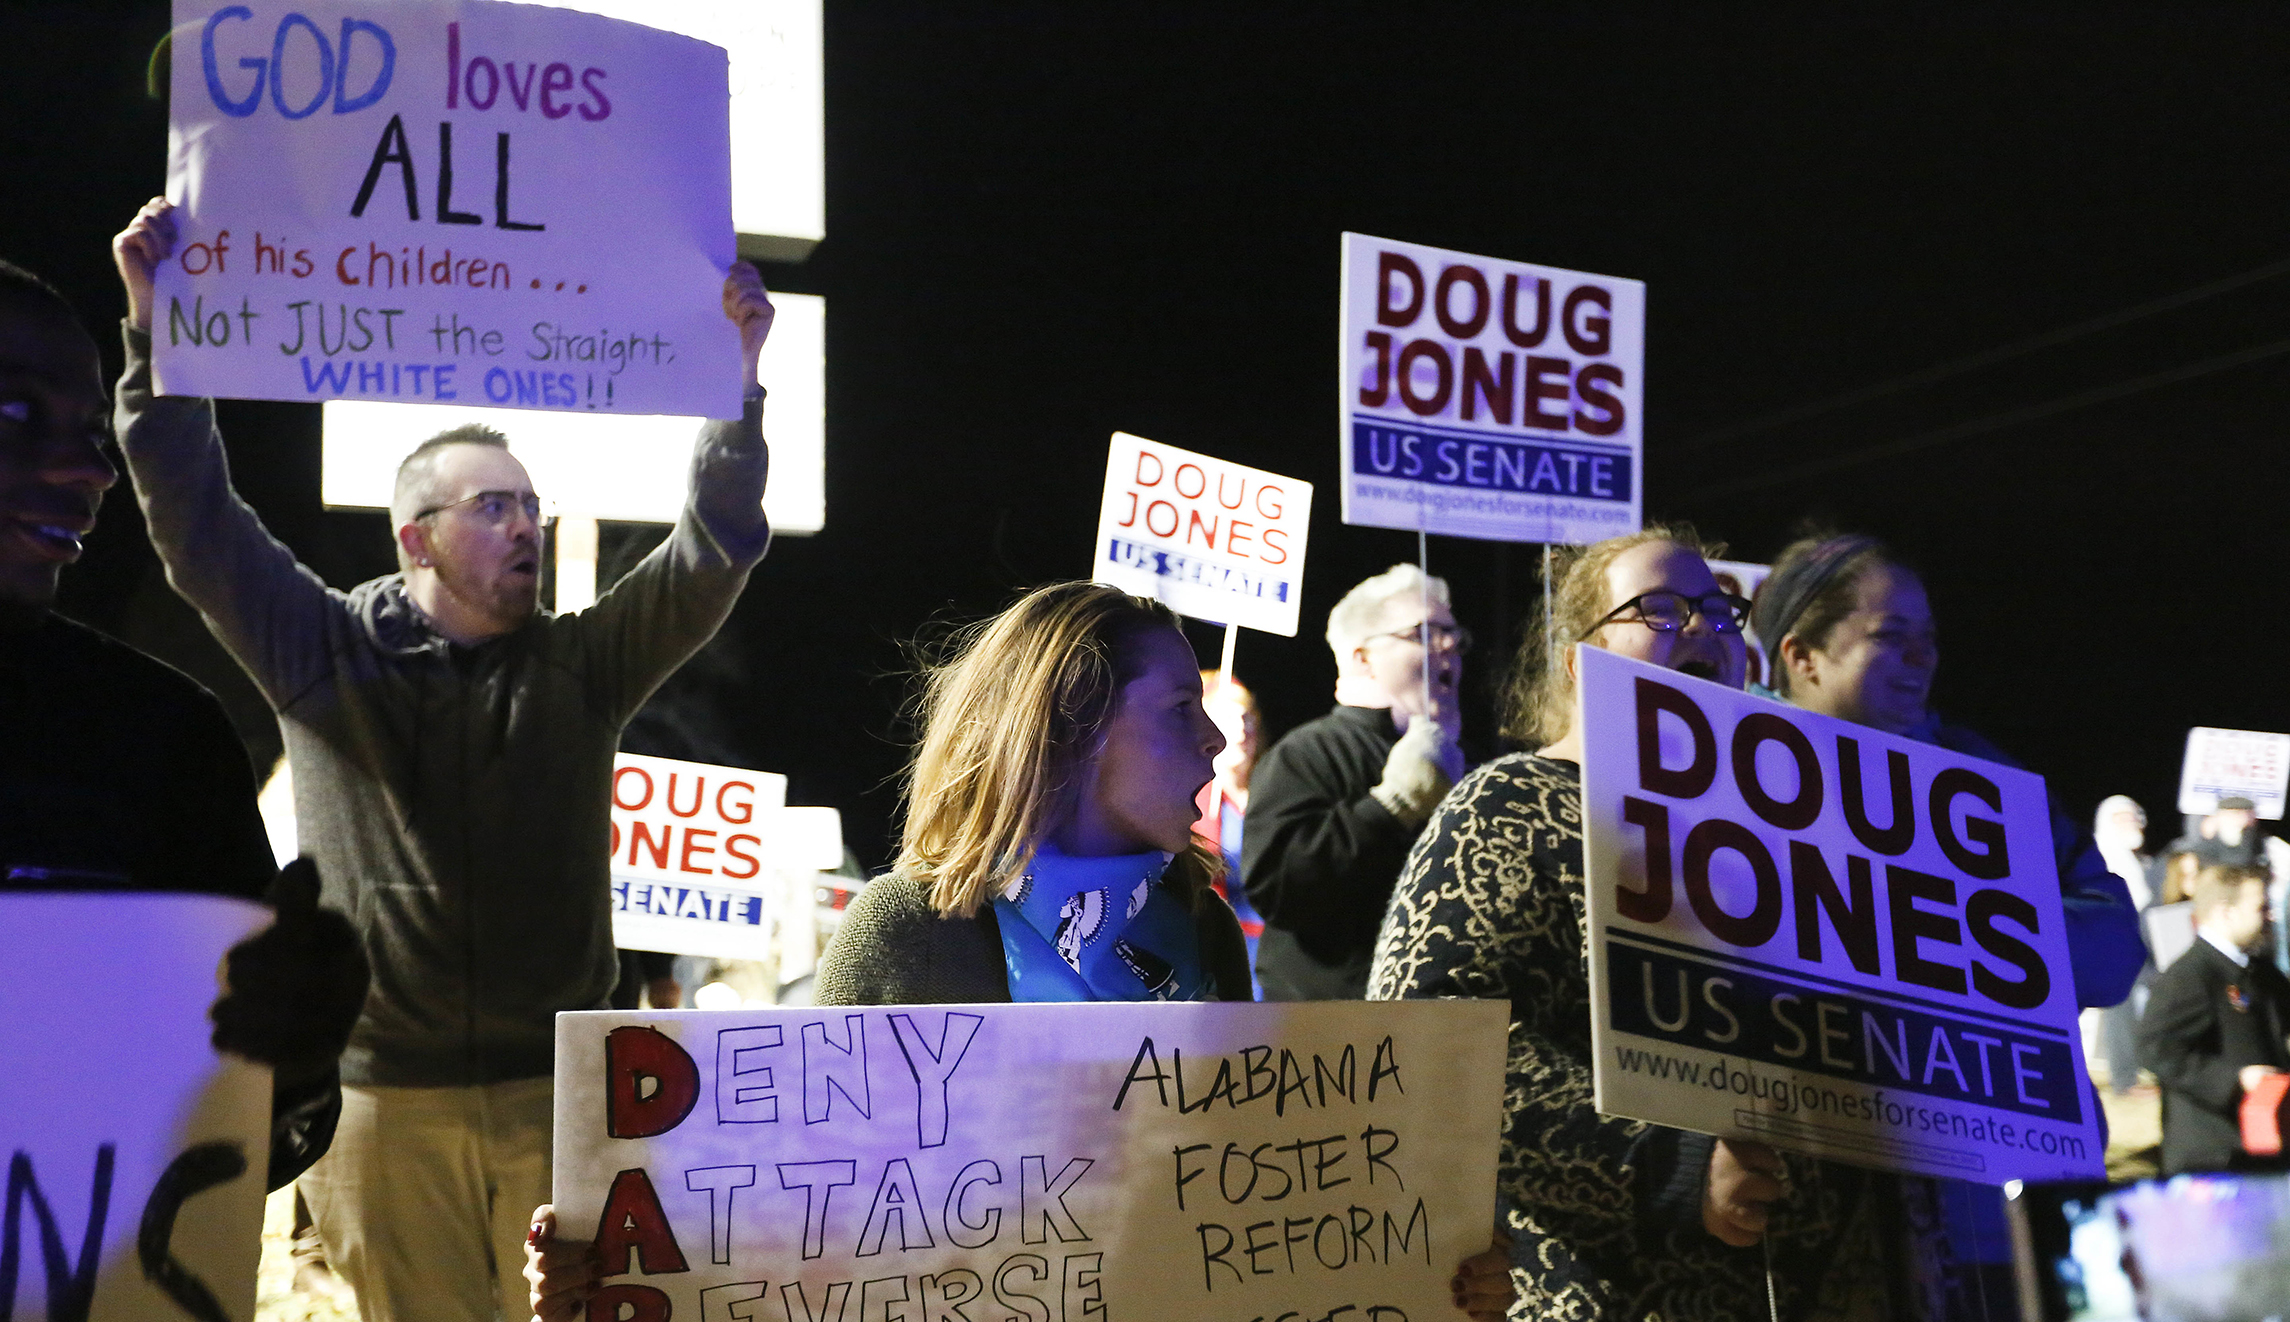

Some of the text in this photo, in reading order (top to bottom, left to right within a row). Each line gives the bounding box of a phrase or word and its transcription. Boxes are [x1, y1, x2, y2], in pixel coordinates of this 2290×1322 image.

[200, 5, 612, 123] GOD loves
[349, 113, 546, 231] ALL
[180, 230, 230, 276] of
[254, 232, 314, 279] his
[168, 296, 260, 349] Not
[278, 301, 404, 356] JUST
[429, 313, 505, 356] the
[1377, 250, 1612, 356] DOUG
[299, 357, 457, 399] WHITE
[1359, 330, 1627, 437] JONES
[1135, 450, 1286, 520] DOUG
[1369, 430, 1614, 498] US SENATE
[1116, 541, 1160, 573] US
[1118, 491, 1290, 565] JONES
[611, 766, 755, 825] OUG
[1634, 676, 2011, 880] DOUG
[610, 820, 762, 880] NES
[1615, 795, 2052, 1010] JONES
[1112, 1034, 1405, 1118] ALABAMA
[1641, 960, 2051, 1110] US SENATE
[605, 1012, 985, 1151] DENY
[1615, 1044, 2087, 1161] www.dougjonesforsenate.com
[1172, 1123, 1405, 1212] FOSTER
[597, 1155, 1095, 1276] ATTACK
[1197, 1196, 1431, 1292] REFORM
